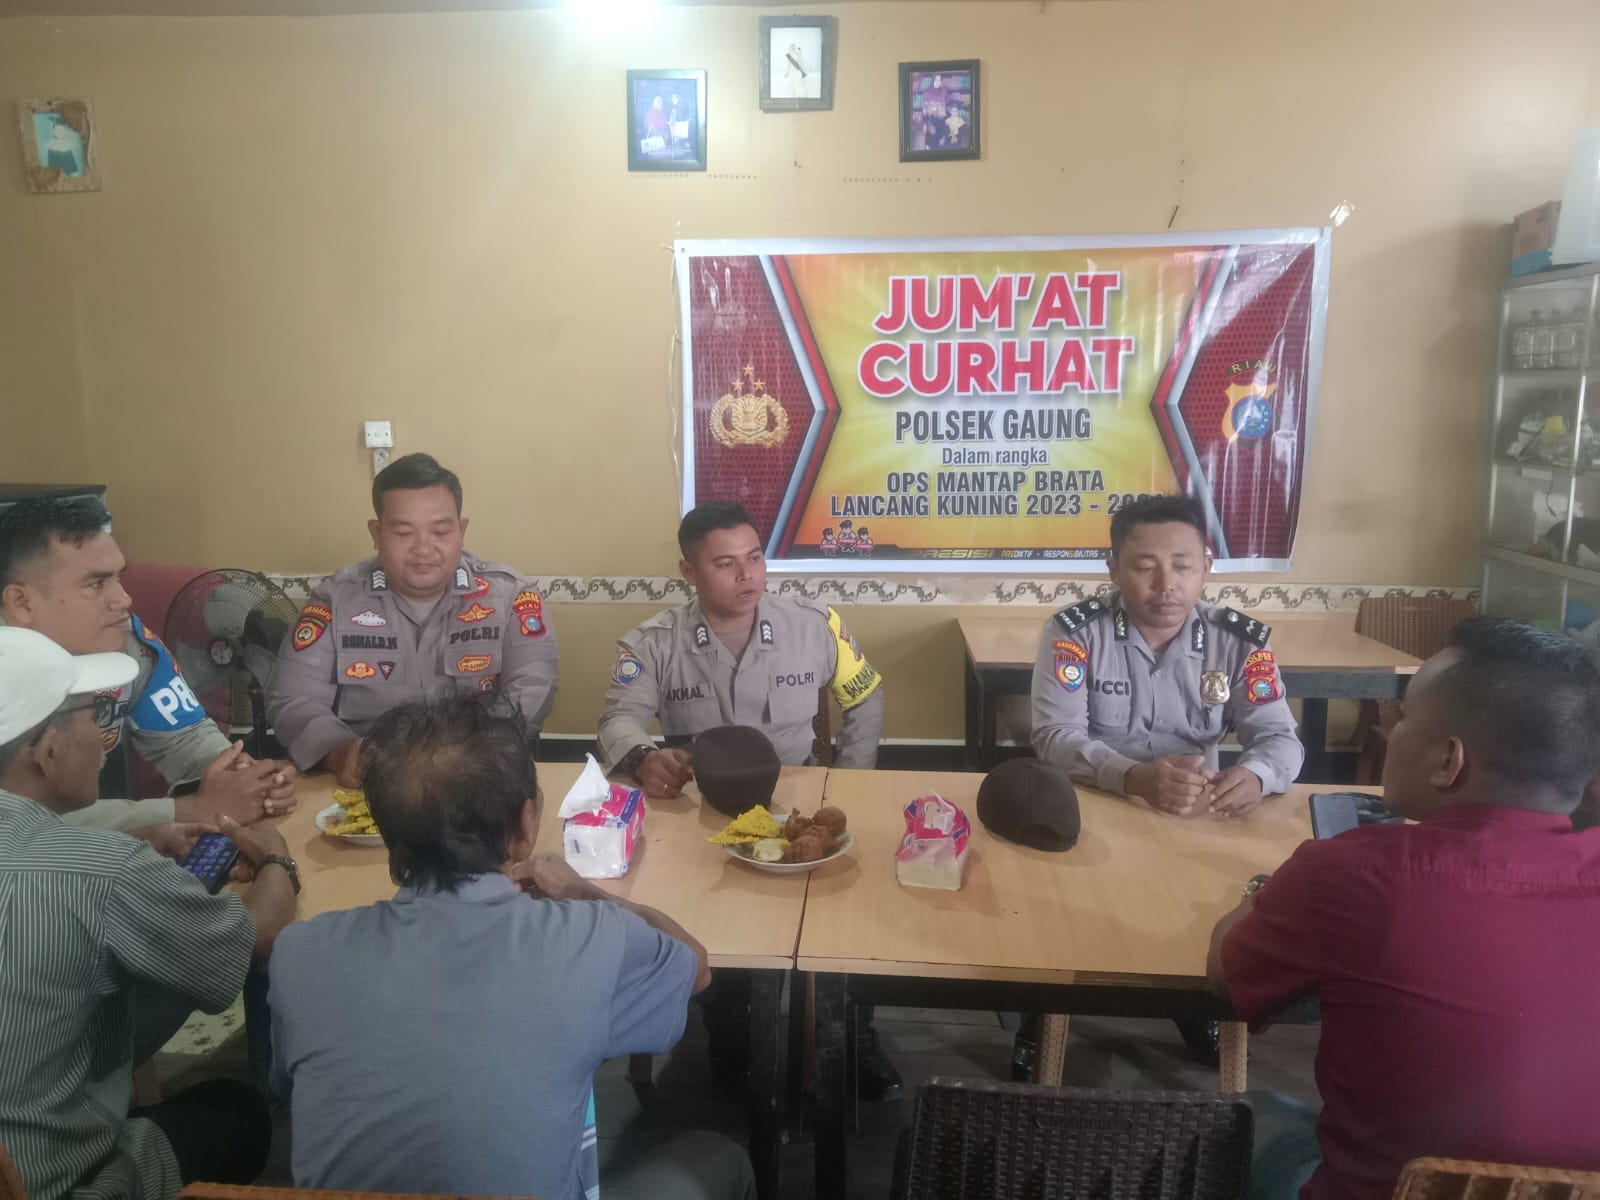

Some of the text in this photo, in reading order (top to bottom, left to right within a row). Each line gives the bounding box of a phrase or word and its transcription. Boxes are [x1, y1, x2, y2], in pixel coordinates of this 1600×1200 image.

[872, 271, 1121, 334] JUM'AT
[858, 336, 1135, 397] CURHAT
[1231, 359, 1277, 374] RIAU
[896, 408, 1091, 442] POLSEK GAUNG
[942, 447, 1047, 467] Dalam rangka
[887, 469, 1104, 493] OPS MANTAP BRATA
[831, 495, 929, 517] LANCANG
[937, 494, 1018, 516] KUNING
[1026, 494, 1081, 515] 2023
[1001, 549, 1034, 559] PREDIKTIF
[449, 626, 500, 645] POLRI
[776, 671, 815, 688] POLRI
[665, 685, 705, 702] AKMAL
